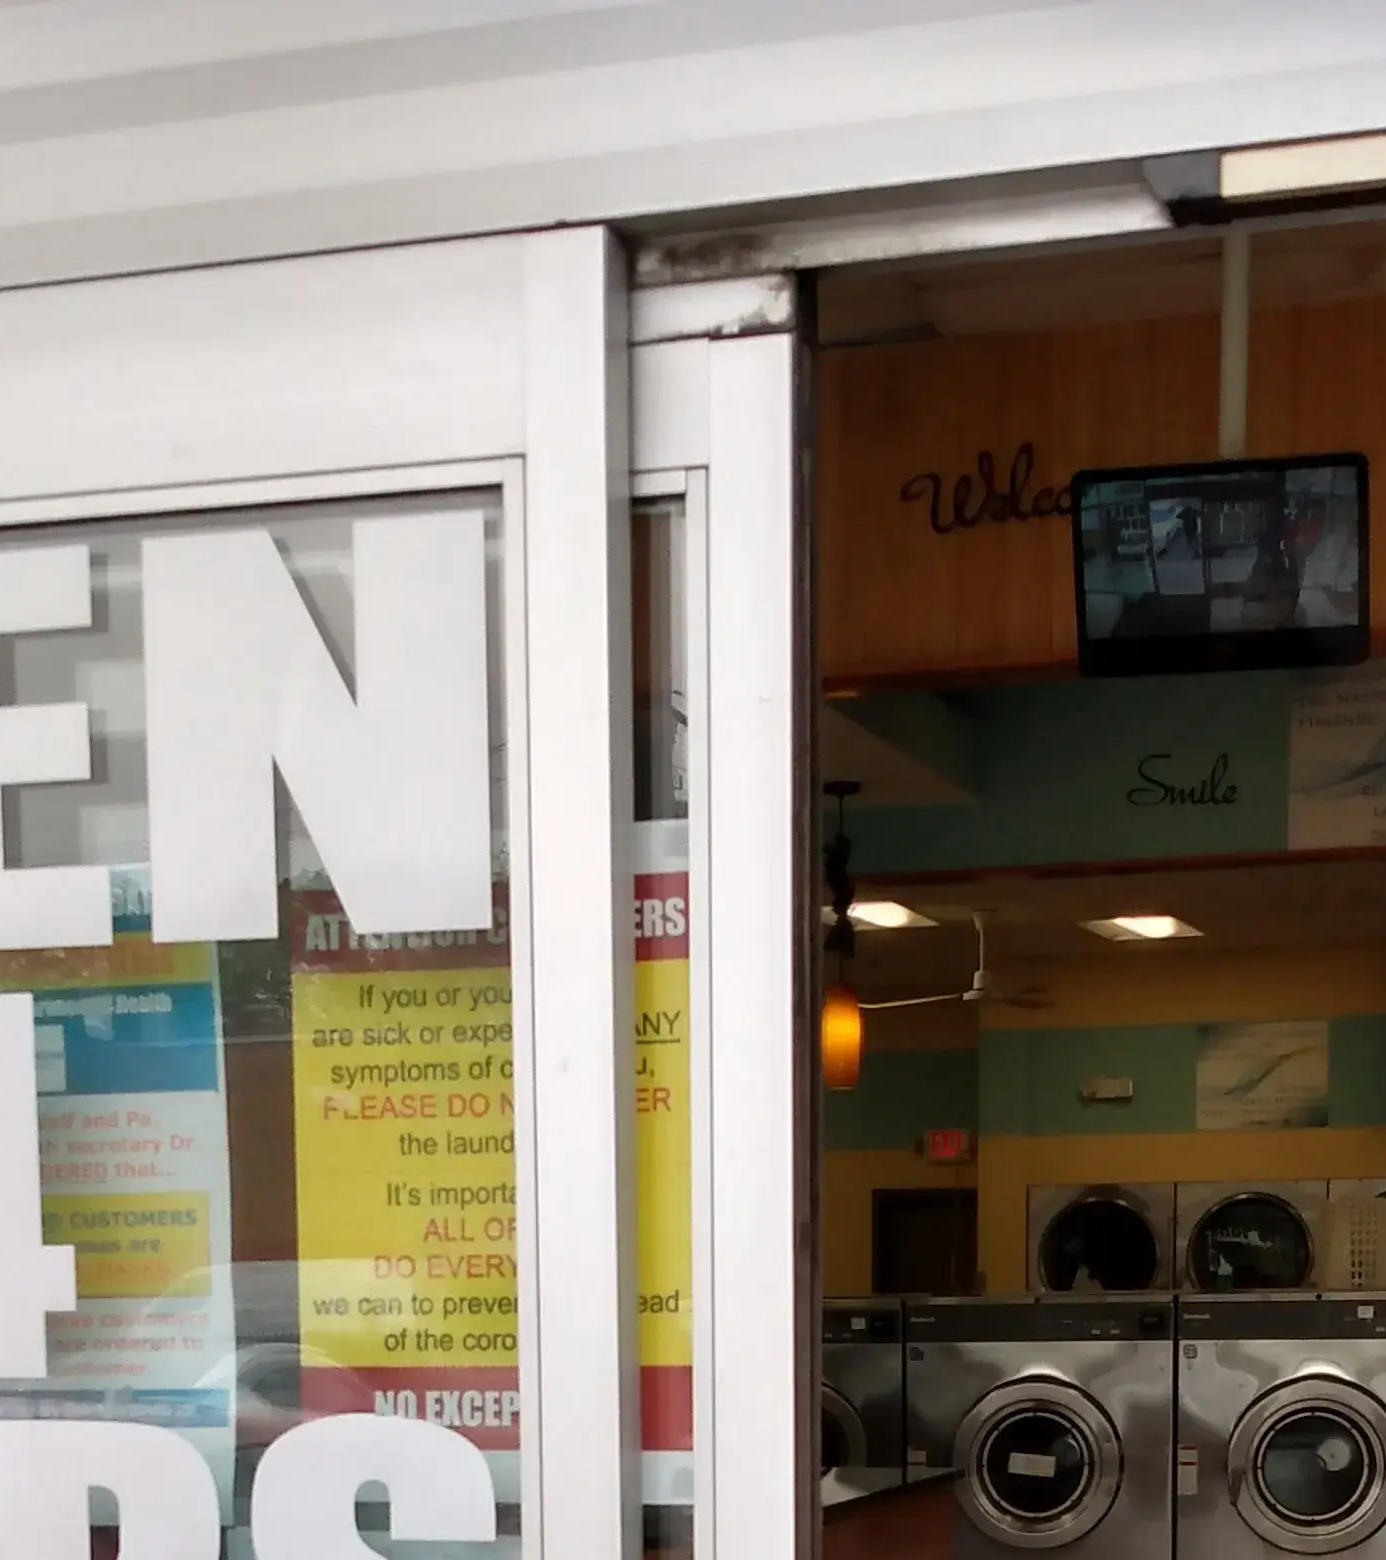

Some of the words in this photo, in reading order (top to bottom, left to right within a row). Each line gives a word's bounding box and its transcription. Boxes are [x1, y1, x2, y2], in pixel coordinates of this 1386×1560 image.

[900, 441, 1072, 534] Welco
[1126, 754, 1239, 806] Smile
[634, 897, 687, 938] ERS
[359, 985, 374, 1008] If
[382, 989, 428, 1014] you
[435, 987, 462, 1006] or
[468, 985, 513, 1011] you
[312, 1027, 354, 1048] are
[363, 1021, 411, 1046] sick
[418, 1025, 443, 1044] or
[452, 1023, 513, 1048] expe
[330, 1060, 461, 1090] symptoms
[468, 1055, 493, 1080] of
[323, 1094, 437, 1120] PLEASE
[447, 1092, 491, 1118] DO
[399, 1132, 438, 1156] the
[446, 1130, 514, 1155] laund
[387, 1182, 421, 1207] It's
[430, 1180, 516, 1210] importa
[70, 1208, 197, 1229] CUSTOMERS
[423, 1217, 475, 1243] ALL
[374, 1255, 417, 1279] DO
[427, 1254, 517, 1279] EVERY
[313, 1297, 350, 1316] we
[358, 1296, 403, 1316] can
[412, 1296, 435, 1316] to
[443, 1295, 518, 1320] preve
[638, 1290, 680, 1314] ead
[384, 1328, 407, 1351] of
[416, 1328, 453, 1351] the
[462, 1332, 517, 1351] coro
[374, 1390, 418, 1419] NO
[425, 1390, 520, 1428] EXCEP
